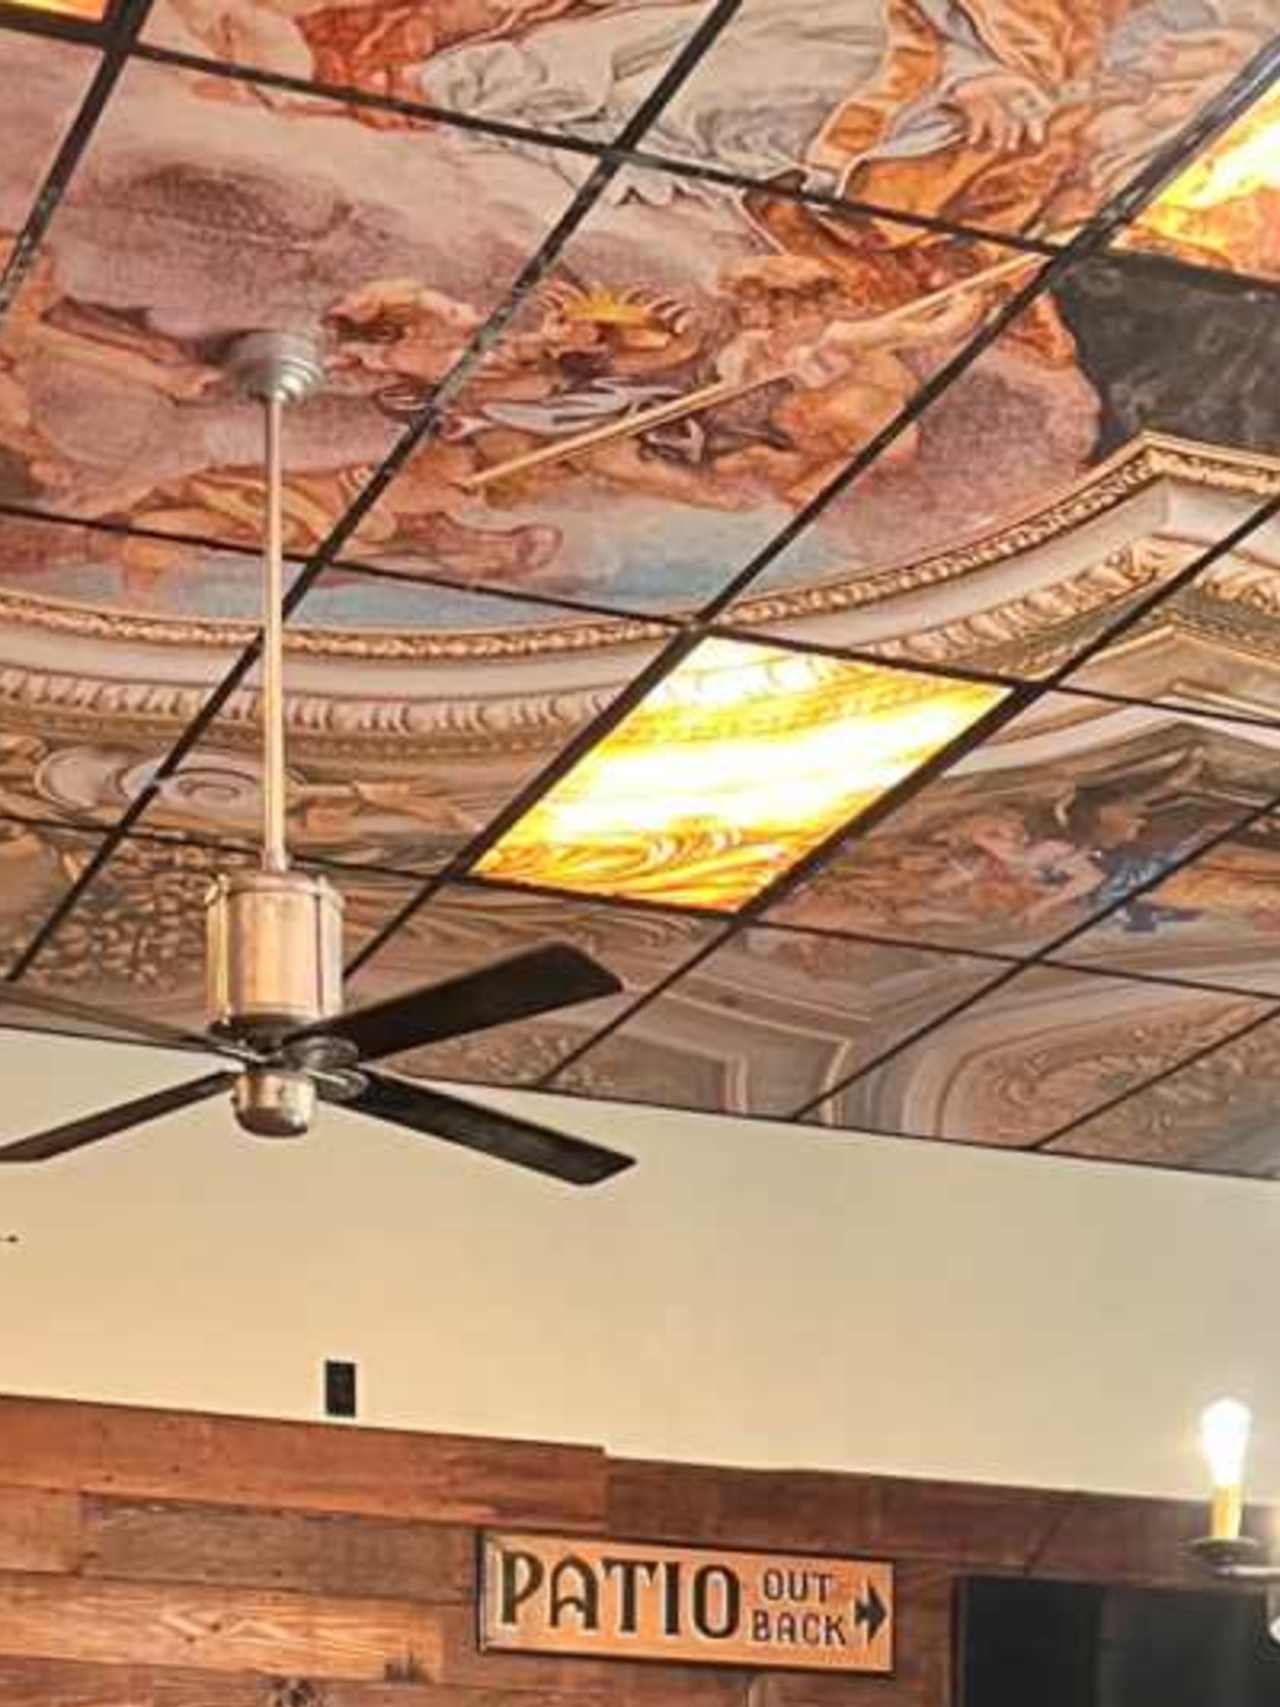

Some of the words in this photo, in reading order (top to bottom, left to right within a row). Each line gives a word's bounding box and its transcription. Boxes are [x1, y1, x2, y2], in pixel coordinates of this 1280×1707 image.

[500, 1551, 741, 1640] PATIO
[762, 1569, 833, 1604] OUT
[752, 1610, 847, 1646] BACK
